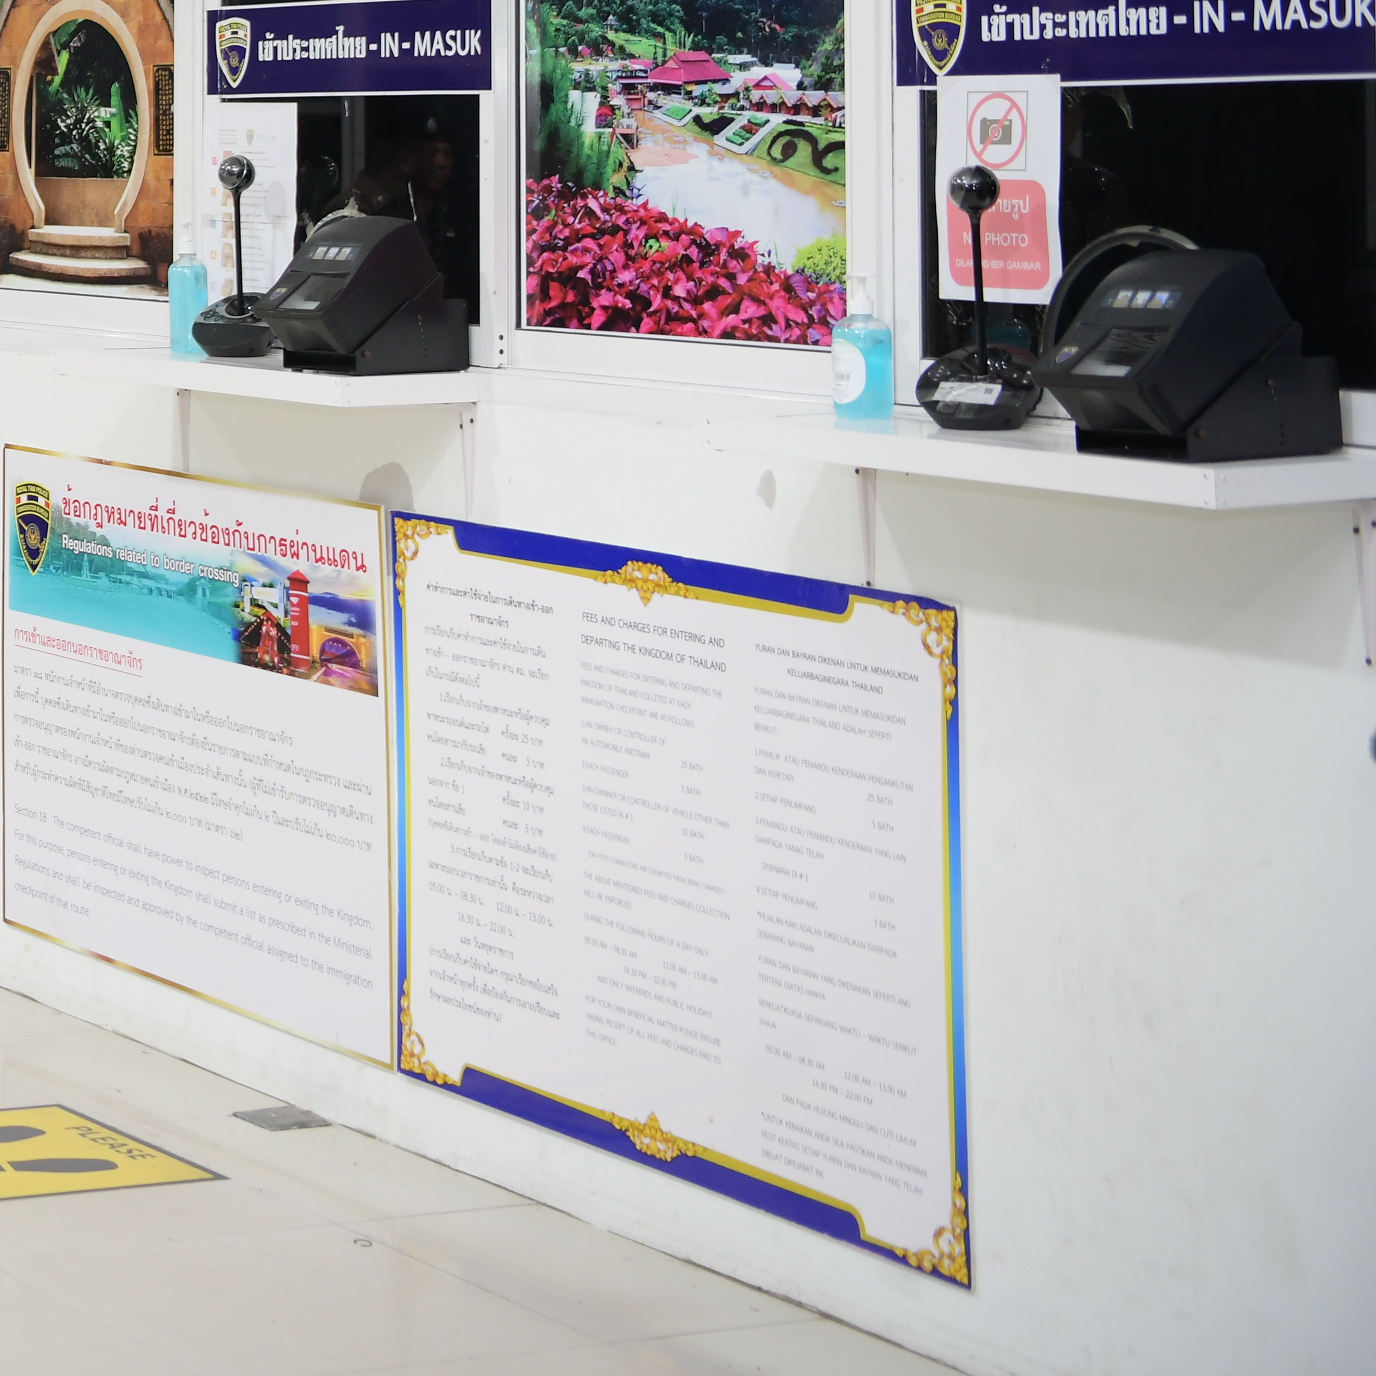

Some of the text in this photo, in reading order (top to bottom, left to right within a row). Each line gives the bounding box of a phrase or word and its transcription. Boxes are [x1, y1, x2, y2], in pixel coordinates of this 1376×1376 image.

[257, 25, 366, 62] เข้าประเทศไทย
[413, 28, 482, 58] MASUK
[984, 232, 1029, 247] PHOTO
[1006, 260, 1042, 271] GAMBAR
[61, 484, 368, 574] ข้อกฎหมายที่เกี่ยวข้องกับการผ่านแดน
[61, 533, 114, 559] Regulations
[115, 543, 148, 566] related
[150, 554, 160, 568] to
[163, 556, 195, 575] border
[197, 565, 240, 588] crossing
[13, 621, 143, 671] การเข้าและออกนอกราชอาณาจักร
[581, 610, 725, 649] FEES AND CHARGES FOR ENTERING AND
[580, 633, 727, 673] DEPARTING THE KINGDOM OF THAILAND
[13, 801, 37, 821] Section
[39, 810, 47, 824] 18
[52, 814, 65, 829] The
[65, 819, 102, 844] competent
[102, 829, 124, 849] official
[125, 838, 142, 855] shall
[143, 844, 161, 861] have
[161, 852, 184, 871] power
[184, 858, 193, 872] to
[194, 861, 220, 883] inspect
[221, 872, 250, 893] persons
[251, 879, 282, 904] entering
[283, 892, 293, 905] or
[294, 893, 319, 917] exiting
[320, 901, 335, 919] the
[13, 827, 25, 842] For
[25, 831, 37, 846] this
[65, 847, 91, 867] persons
[91, 854, 118, 877] entering
[119, 865, 127, 877] or
[127, 866, 150, 888] exiting
[150, 873, 163, 889] the
[163, 878, 194, 903] Kingdom
[194, 888, 212, 906] shall
[212, 894, 237, 915] submit
[238, 905, 244, 917] a
[245, 905, 257, 921] list
[257, 912, 266, 925] as
[267, 913, 307, 941] prescribed
[308, 927, 316, 941] in
[317, 930, 331, 947] the
[332, 935, 372, 961] Ministerial
[51, 867, 63, 882] and
[64, 871, 80, 888] shall
[81, 877, 92, 892] be
[93, 881, 125, 906] inspected
[126, 892, 140, 908] and
[140, 897, 174, 923] approved
[174, 909, 184, 927] by
[185, 913, 198, 929] the
[198, 918, 239, 946] competent
[240, 931, 265, 953] official
[266, 941, 298, 968] assigned
[299, 954, 309, 969] to
[310, 956, 324, 974] the
[325, 962, 373, 994] immigration
[65, 1124, 157, 1162] PLEASE
